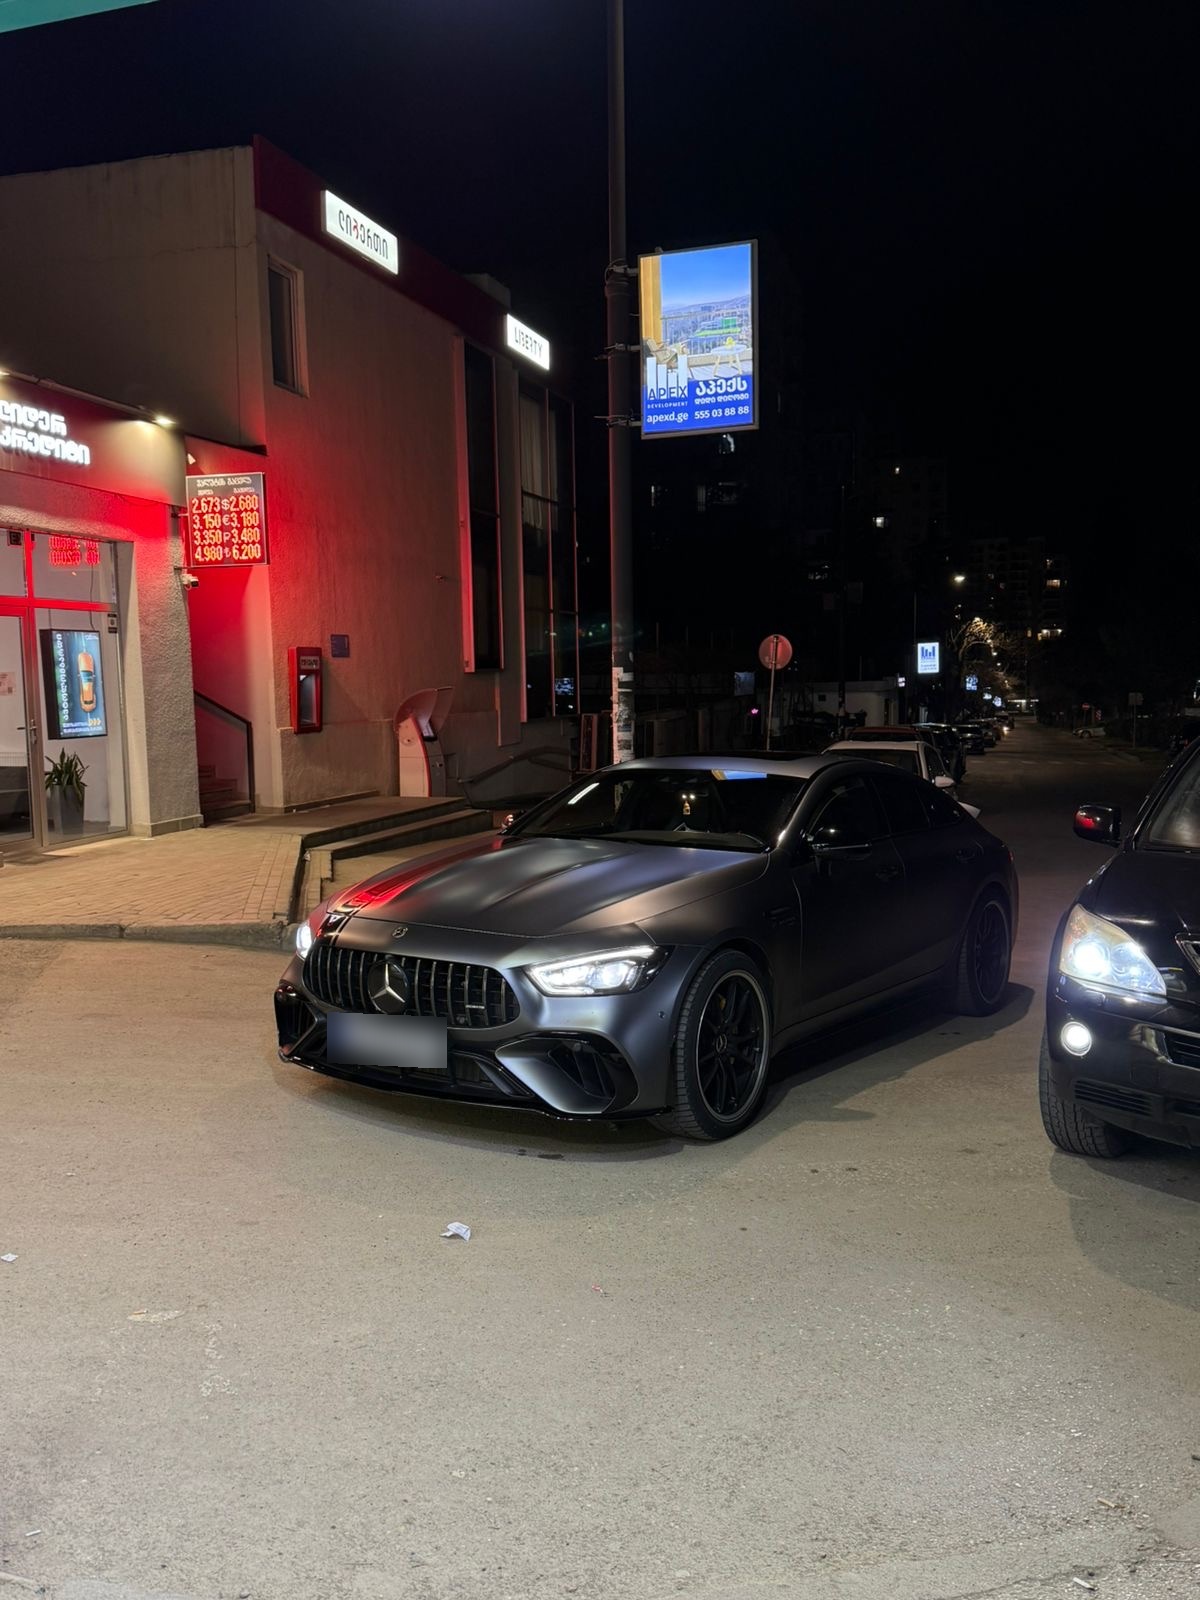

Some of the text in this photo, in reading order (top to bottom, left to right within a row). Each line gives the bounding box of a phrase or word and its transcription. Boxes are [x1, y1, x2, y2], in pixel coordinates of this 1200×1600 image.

[338, 209, 389, 260] ლიბერთი
[514, 326, 543, 359] LIBERTY
[648, 385, 688, 400] APEX
[696, 377, 748, 396] აპექს
[647, 412, 689, 424] apexd.ge
[695, 406, 750, 420] 555 03 88 88
[192, 496, 221, 514] 2.673
[229, 494, 259, 512] 2.680
[193, 529, 223, 546] 3.350
[231, 527, 261, 544] 3.480
[195, 545, 224, 562] 4.980
[232, 543, 261, 560] 6.200
